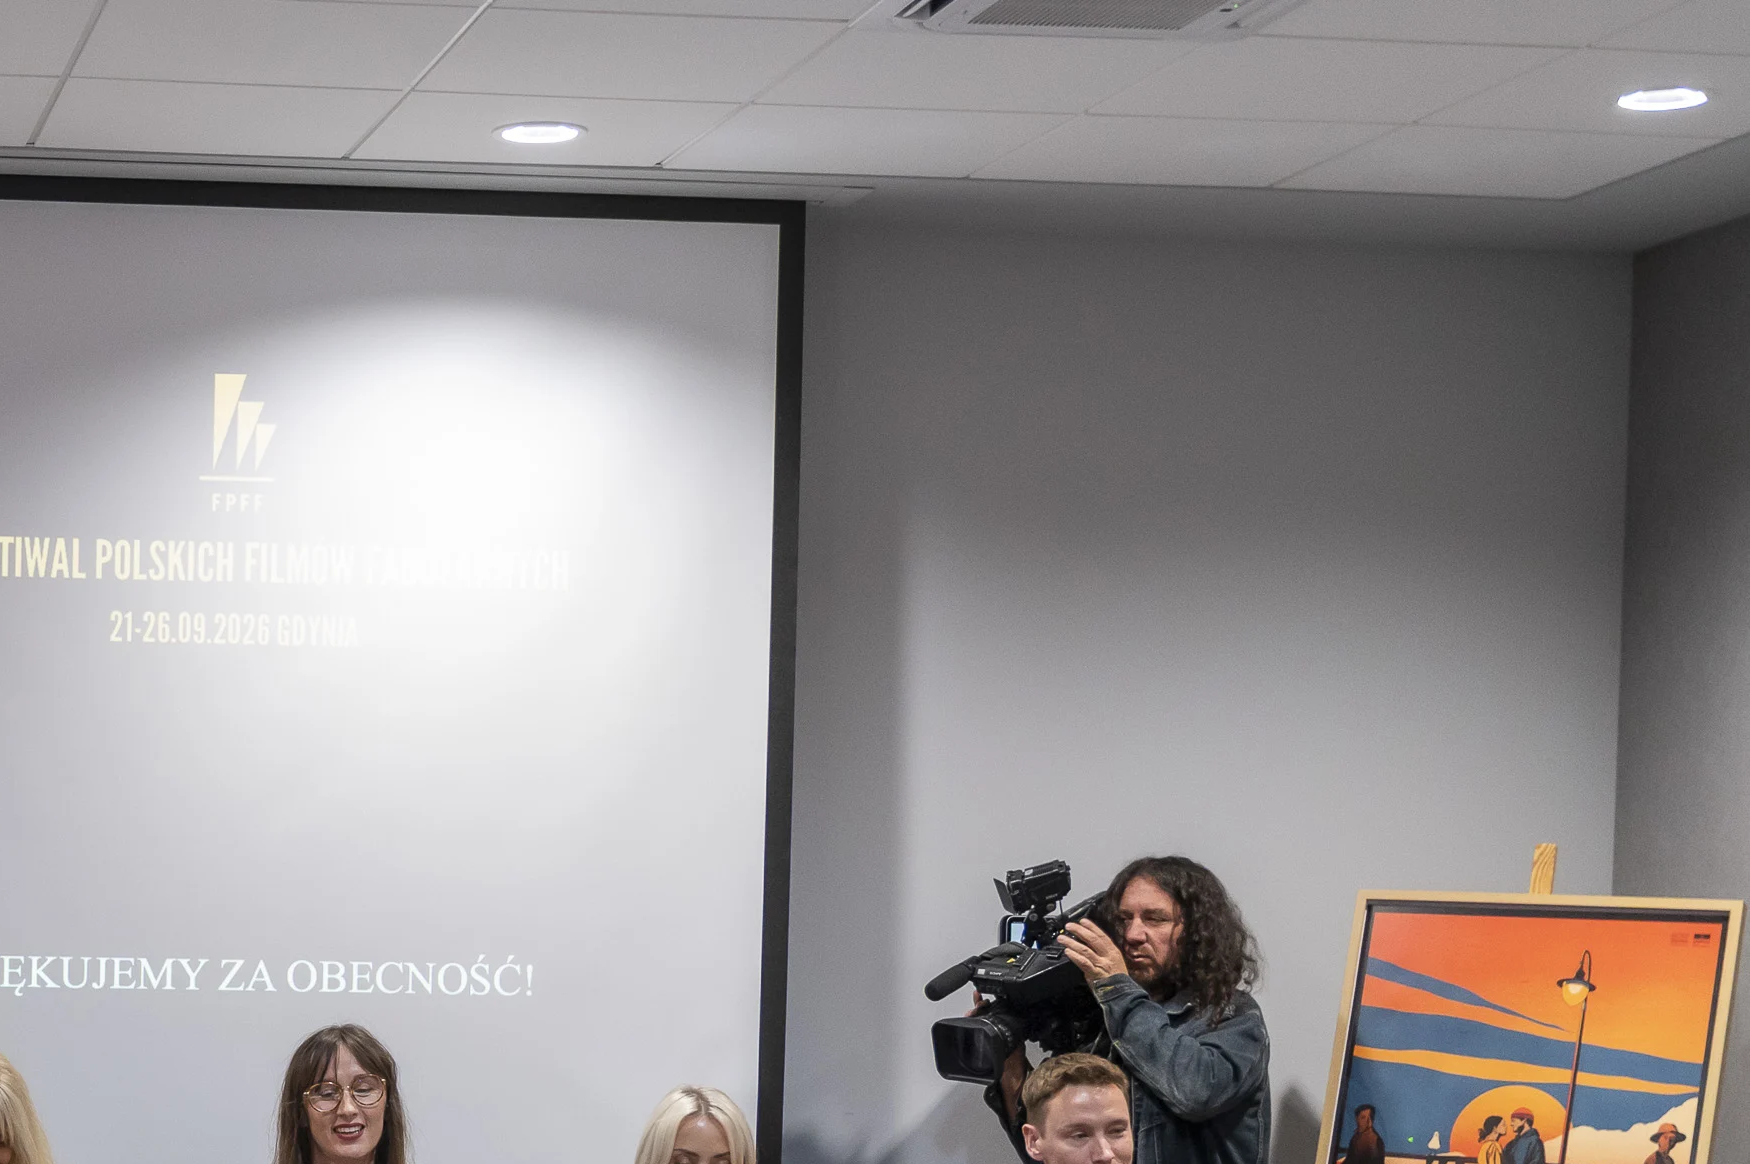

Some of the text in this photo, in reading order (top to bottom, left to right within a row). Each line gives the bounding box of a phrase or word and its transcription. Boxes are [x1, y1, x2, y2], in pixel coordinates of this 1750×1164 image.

[212, 493, 264, 512] FPFF
[95, 538, 234, 583] POLSKICH
[245, 536, 354, 586] FILMÓW
[109, 609, 359, 648] 21-26.09.2026 GDYNIA
[217, 959, 278, 992] ZA
[286, 954, 535, 997] OBECNOŚĆ!
